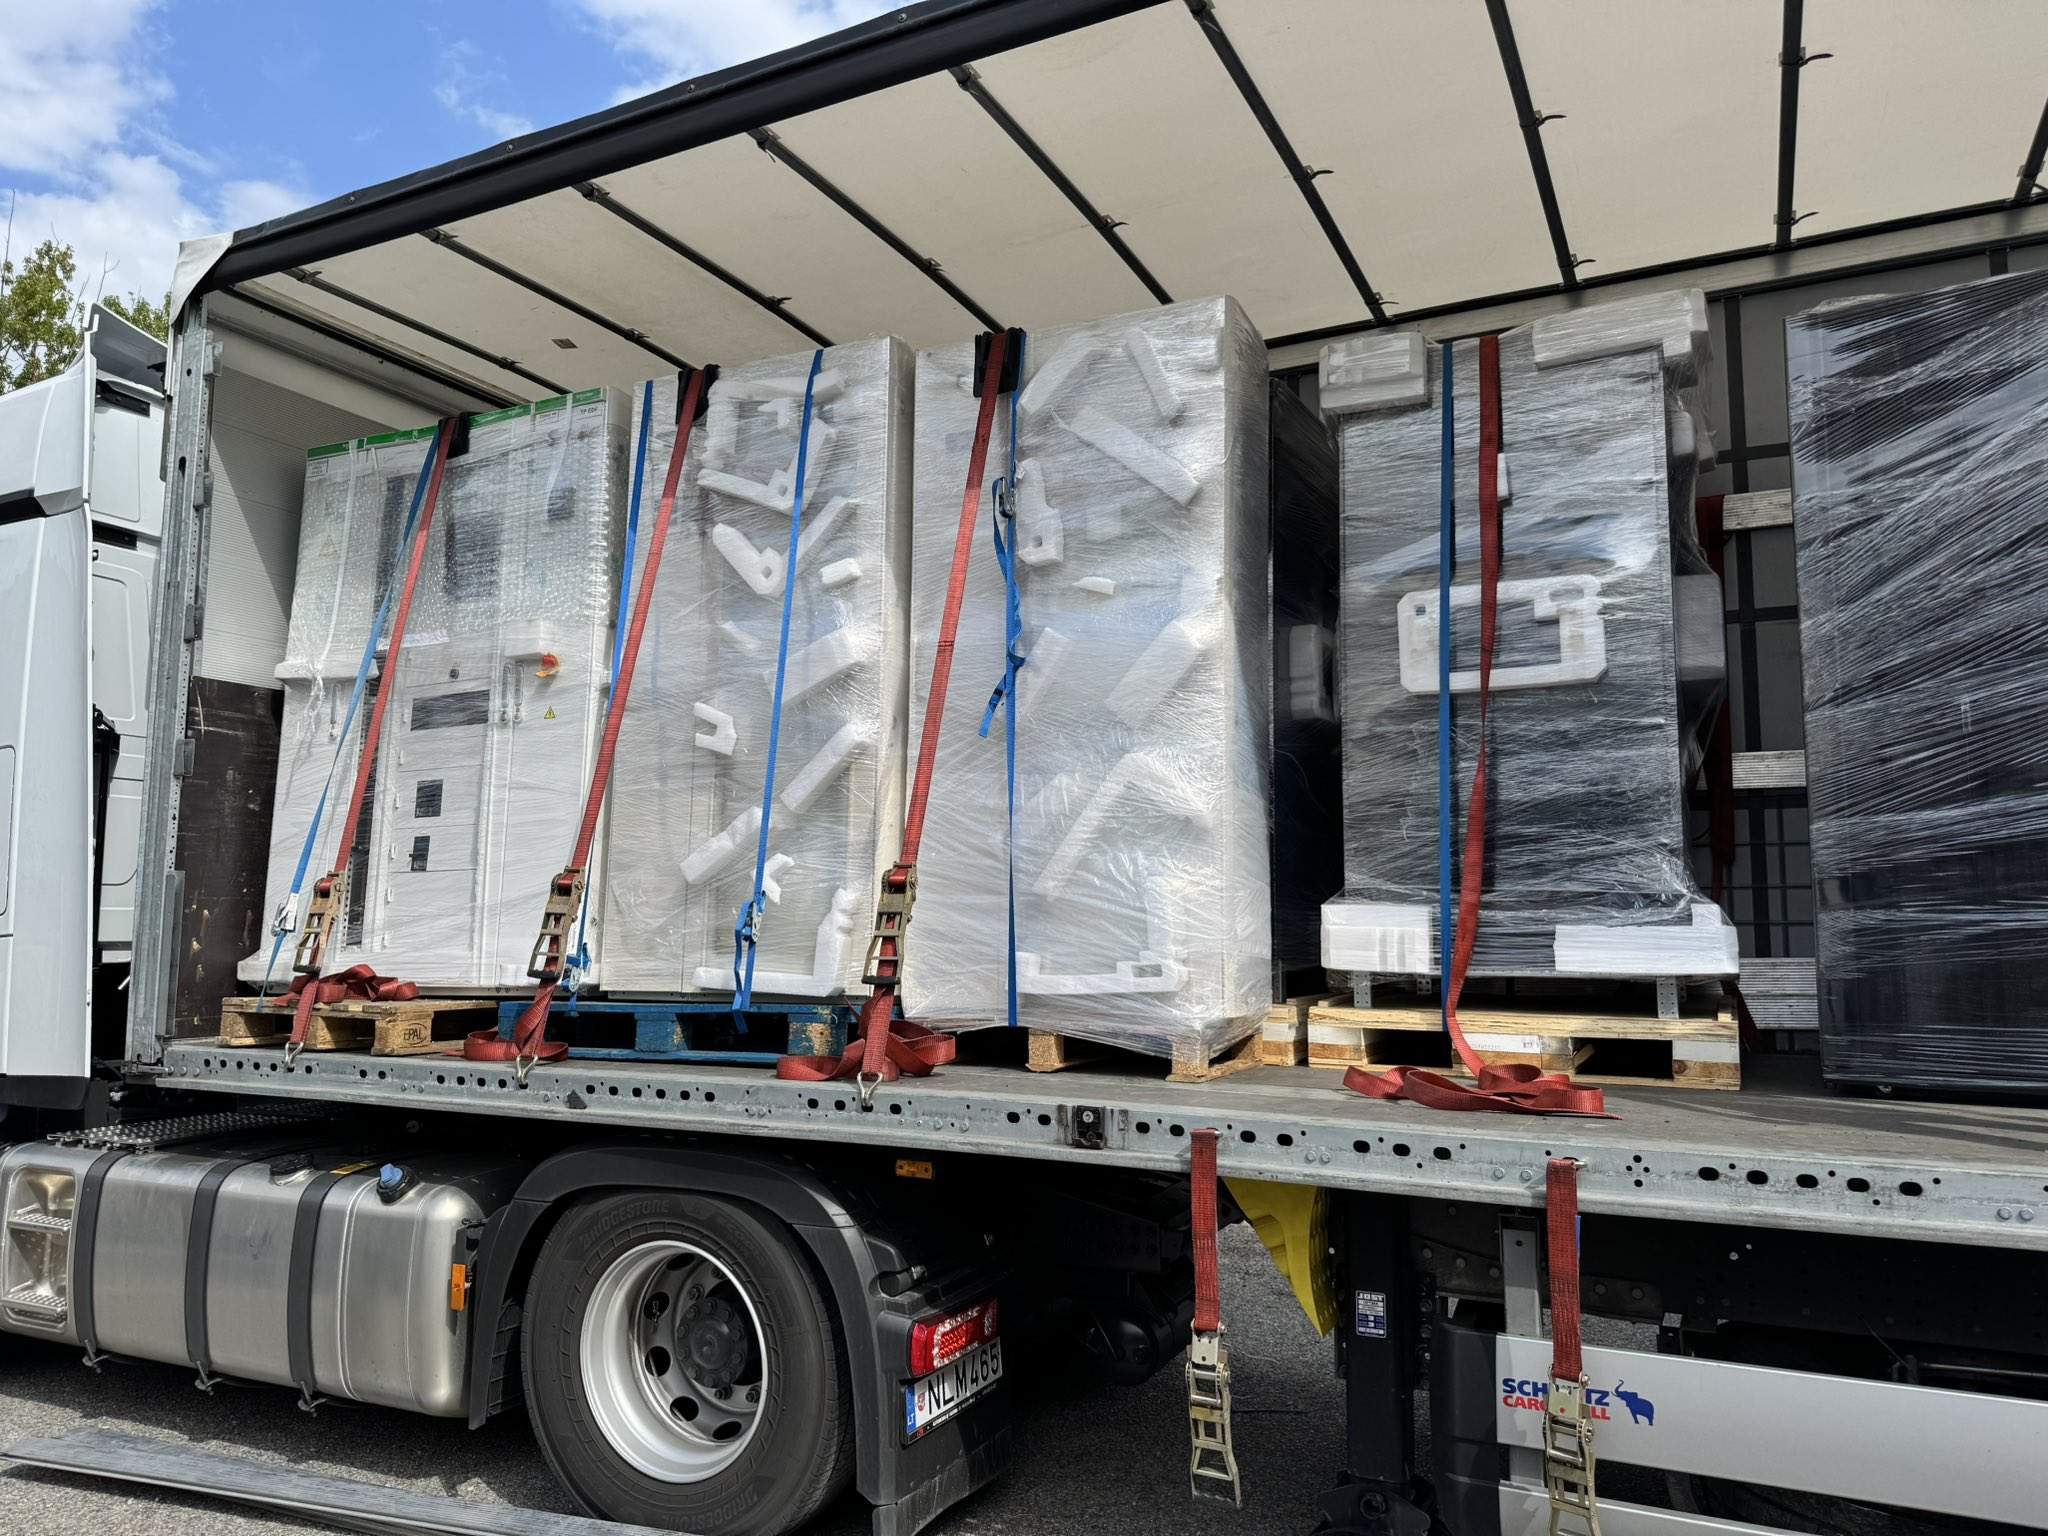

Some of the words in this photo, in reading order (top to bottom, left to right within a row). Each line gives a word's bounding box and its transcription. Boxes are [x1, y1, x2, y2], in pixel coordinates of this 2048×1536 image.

[403, 1027, 422, 1040] EPAL
[579, 1199, 670, 1249] BRIDGESTONE
[1357, 1292, 1384, 1302] JOST
[1502, 1377, 1610, 1407] SCHTZ
